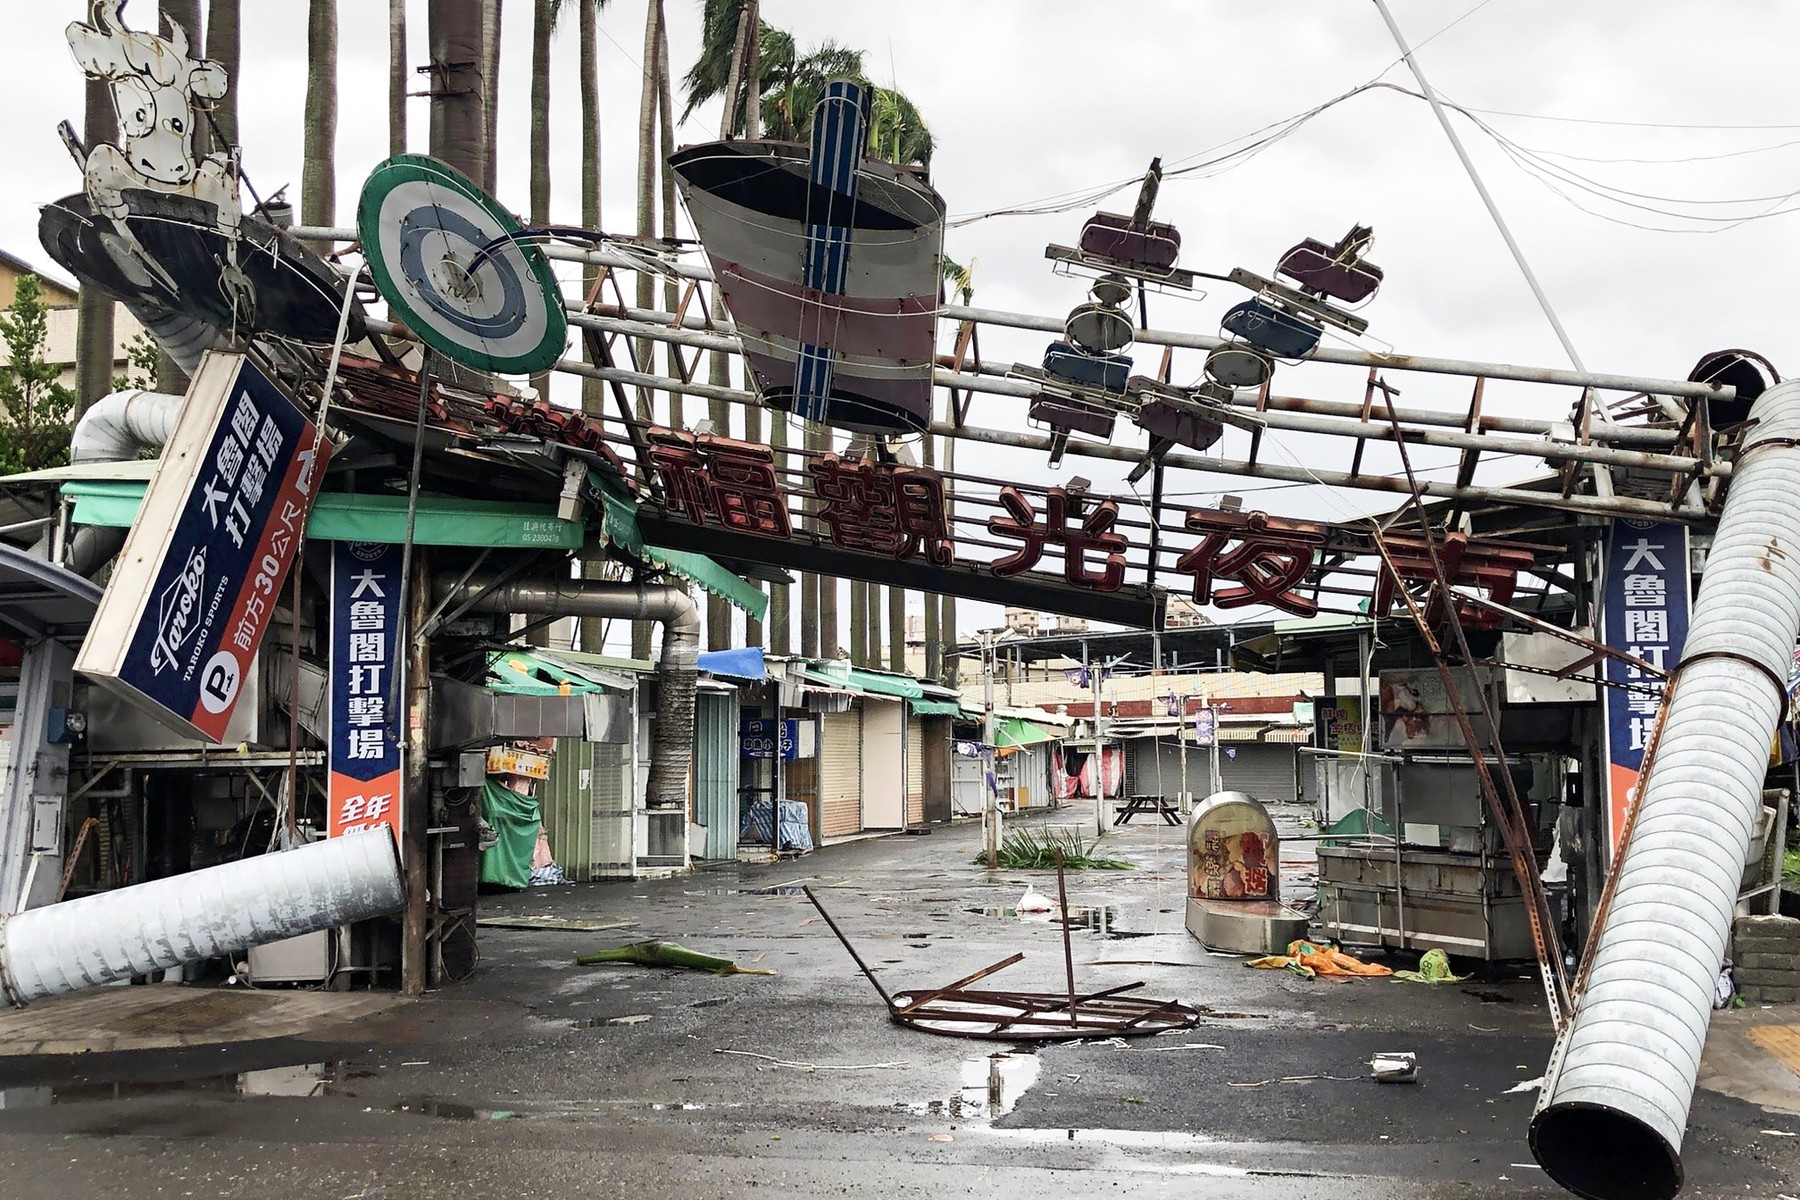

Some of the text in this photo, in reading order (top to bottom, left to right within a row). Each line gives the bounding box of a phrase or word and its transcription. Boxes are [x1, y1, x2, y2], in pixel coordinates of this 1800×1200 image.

[201, 389, 260, 530] 大魯閣
[224, 414, 284, 549] 打擊場
[183, 575, 229, 682] TAROKO SPORTS
[347, 568, 386, 760] 大魯閣打擊場
[338, 793, 392, 824] 全年
